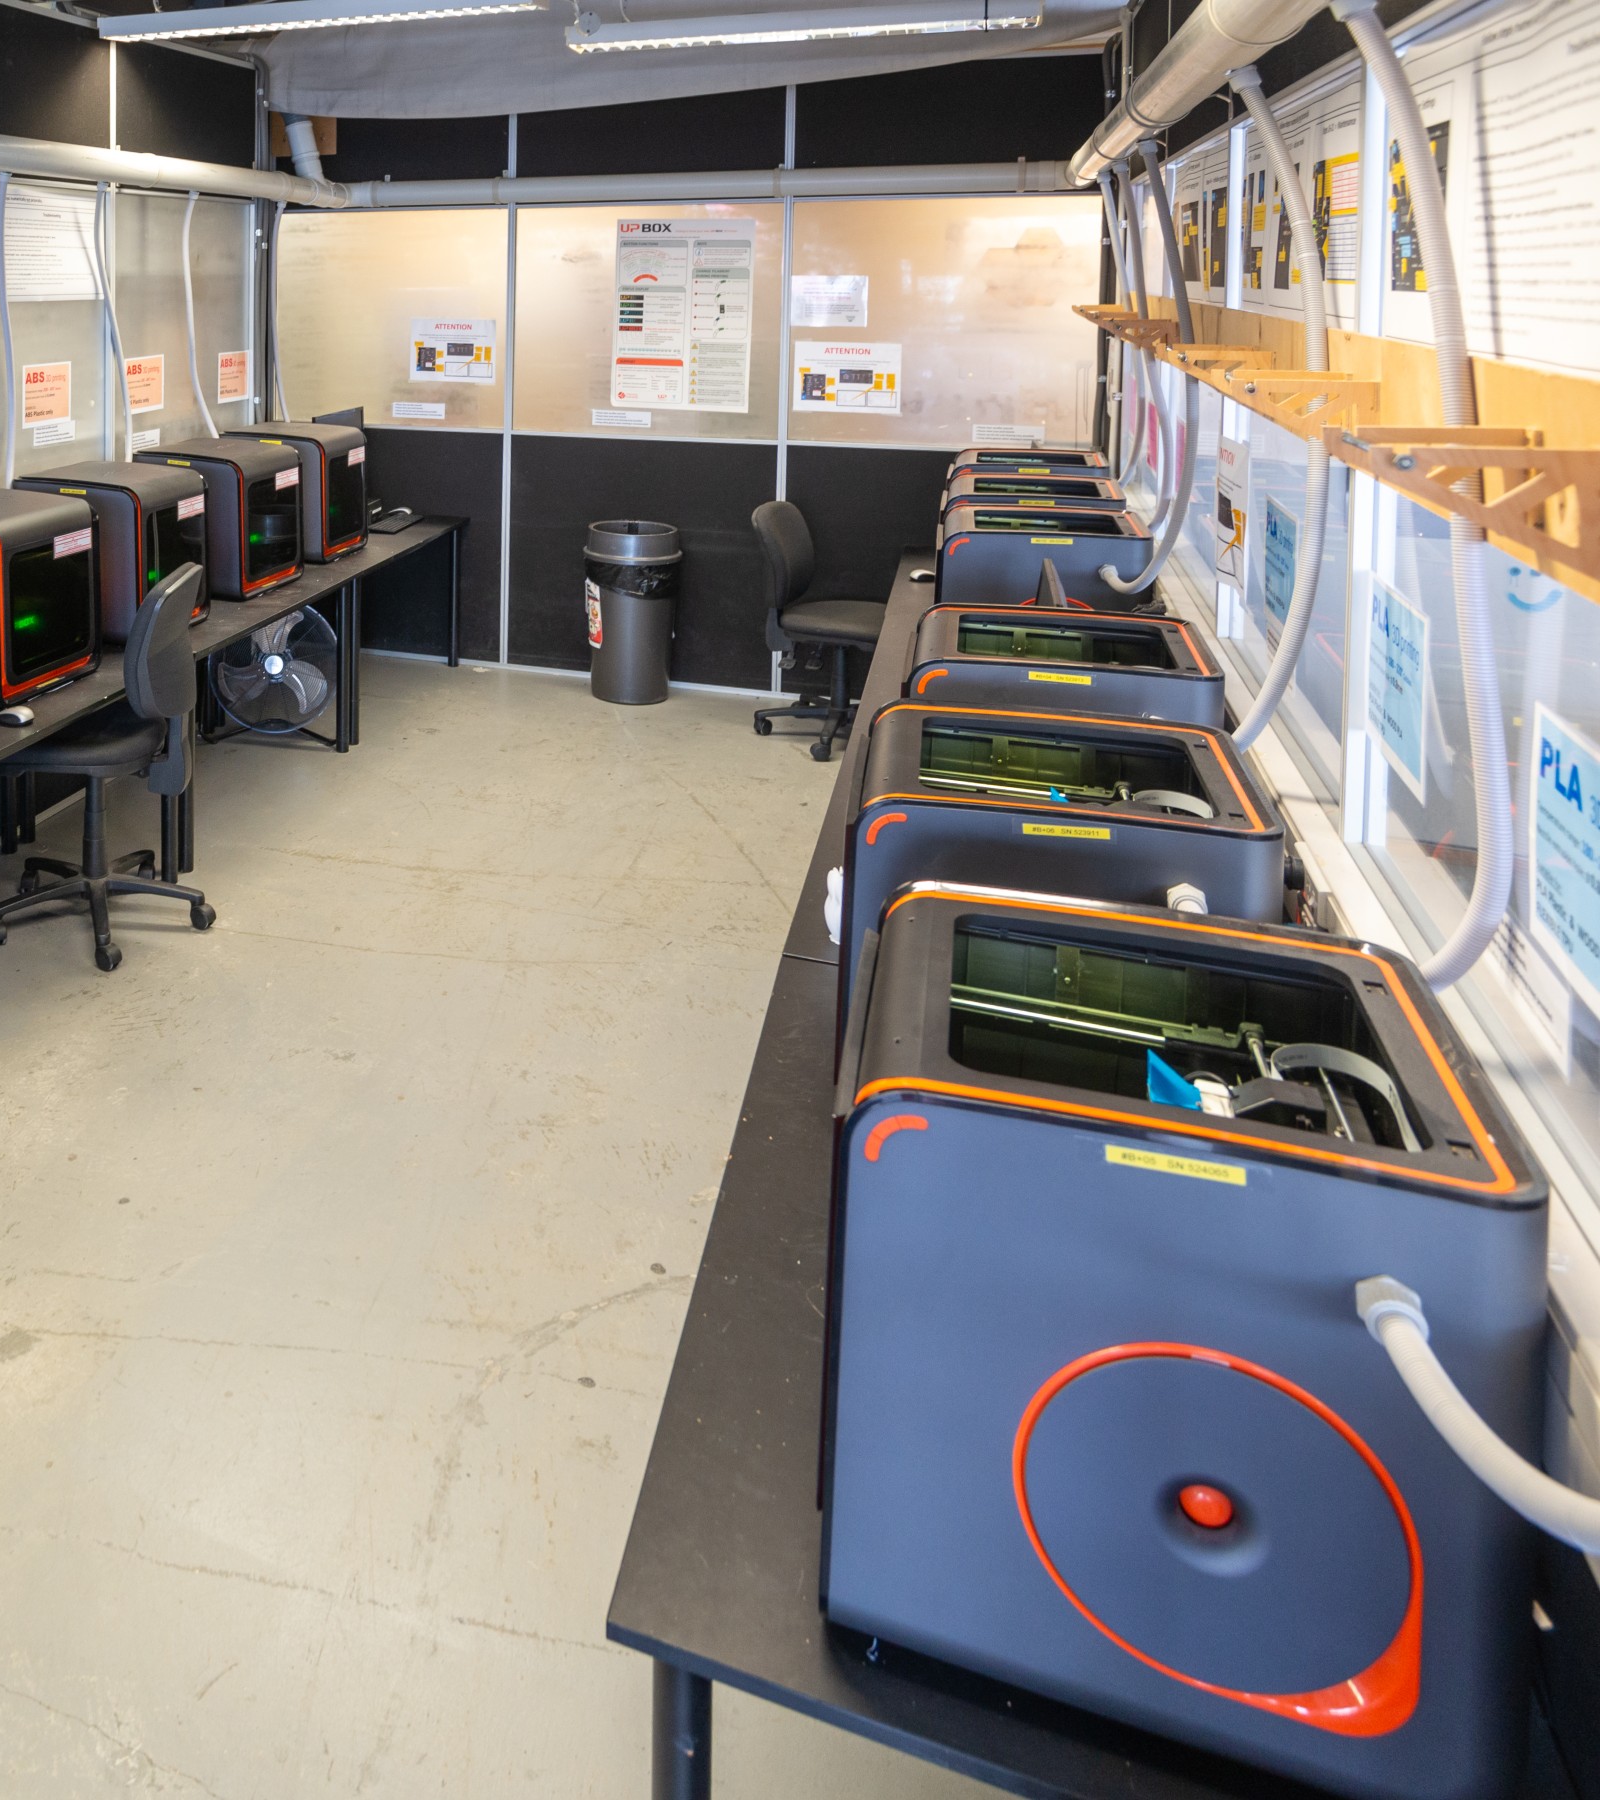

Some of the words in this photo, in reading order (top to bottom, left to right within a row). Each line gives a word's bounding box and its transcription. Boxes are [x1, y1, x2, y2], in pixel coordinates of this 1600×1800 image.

[220, 358, 233, 368] ABS
[127, 364, 142, 376] ABS
[26, 372, 44, 384] ABS
[1540, 737, 1583, 812] PLA
[1122, 1152, 1156, 1166] #B+05
